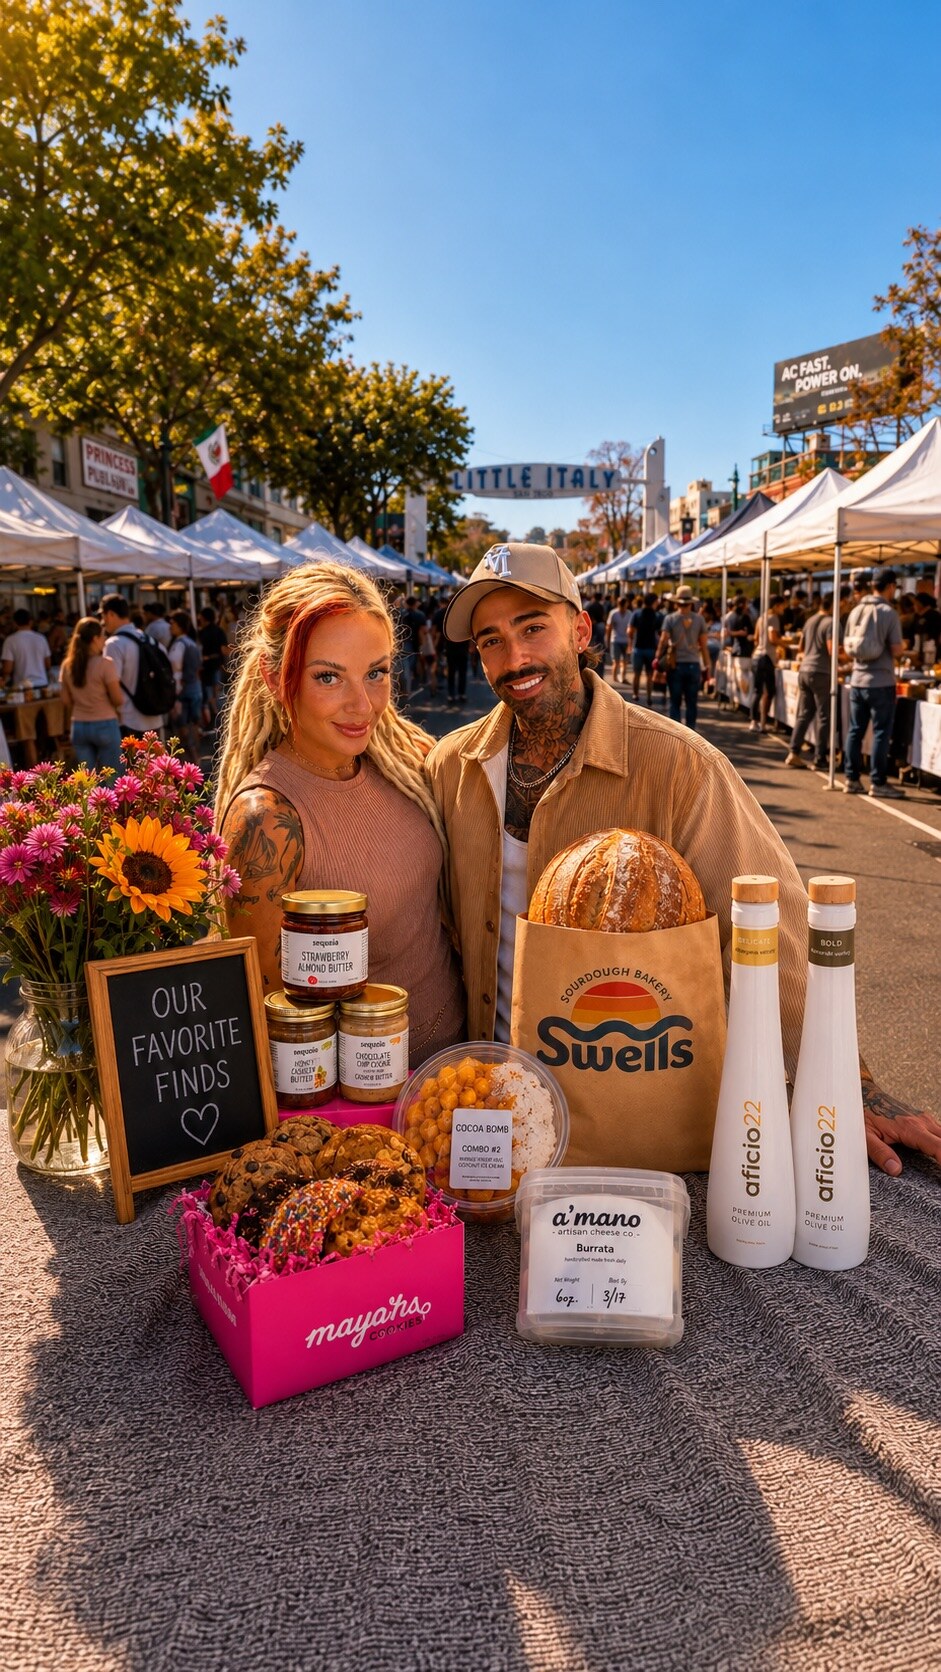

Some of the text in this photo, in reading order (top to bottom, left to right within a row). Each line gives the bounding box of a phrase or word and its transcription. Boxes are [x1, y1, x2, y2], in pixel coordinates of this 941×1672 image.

[782, 356, 831, 382] AC FAST.
[795, 370, 838, 393] POWER
[840, 364, 862, 381] ON.
[86, 444, 136, 476] PRINCESS
[454, 466, 614, 490] LITTLE ITALY
[820, 939, 842, 947] BOLD
[298, 962, 353, 973] ALMOND BUTTER
[302, 951, 350, 962] STRAWBERRY
[560, 967, 672, 1004] SOURDOUGH BAKERY
[152, 982, 206, 1018] OUR
[132, 1017, 242, 1066] FAVORITE
[536, 1015, 694, 1072] Swells
[156, 1060, 230, 1102] FINDS
[456, 1124, 508, 1134] COCOA BOMB
[742, 1100, 761, 1197] aficio22
[816, 1105, 836, 1202] aficio22
[552, 1204, 641, 1228] a'mano
[732, 1206, 771, 1216] PREMIUM
[732, 1216, 771, 1226] OLIVE OIL
[806, 1210, 844, 1222] PREMIUM
[590, 1228, 620, 1236] cheese
[804, 1220, 844, 1232] OLIVE OIL
[576, 1244, 614, 1254] Burrata
[556, 1287, 626, 1308] 6oz. 3/17
[369, 1317, 422, 1341] COOKIES
